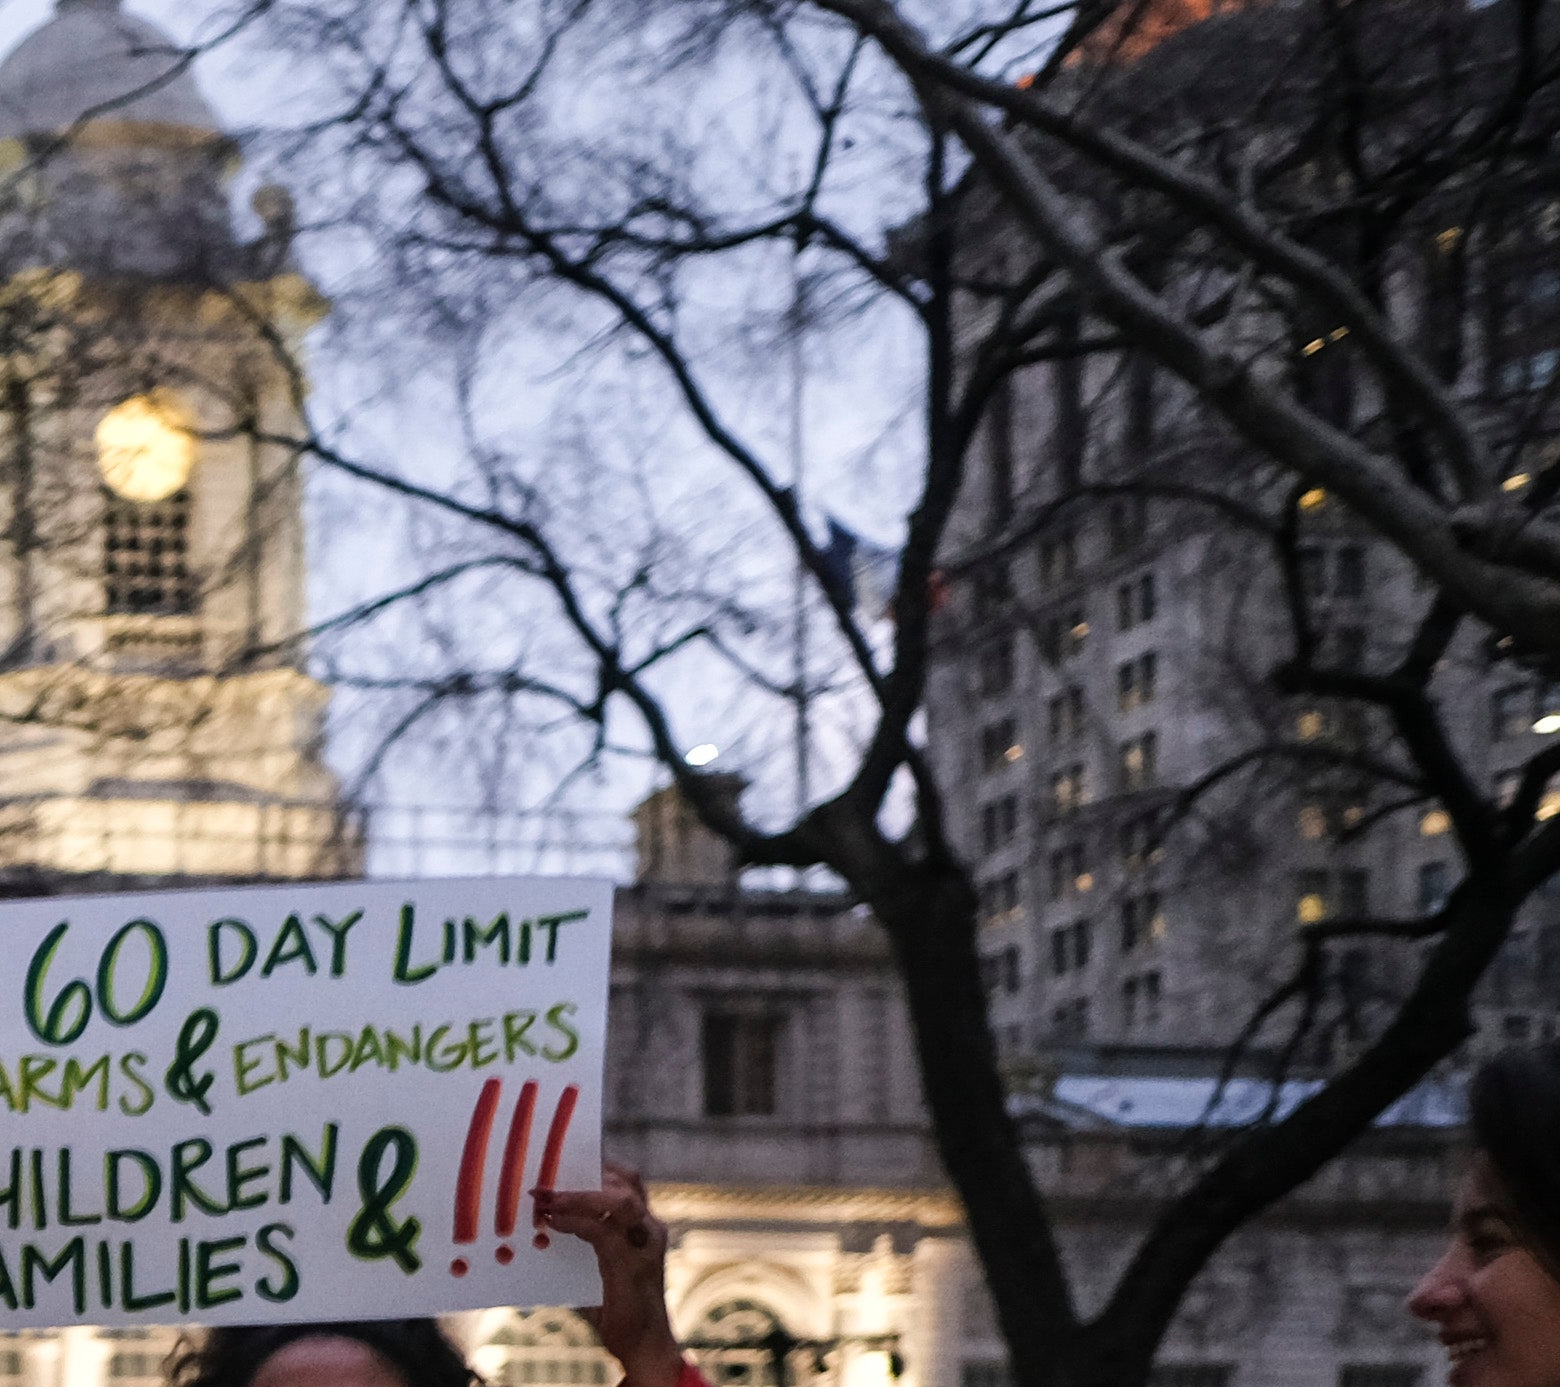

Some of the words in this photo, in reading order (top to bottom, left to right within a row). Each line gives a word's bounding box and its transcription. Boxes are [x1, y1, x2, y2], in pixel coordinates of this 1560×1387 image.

[23, 920, 170, 1047] 60
[208, 909, 364, 988] DAY
[392, 905, 590, 986] LIMIT
[165, 1008, 221, 1116] &
[235, 1003, 580, 1097] ENDANGERS
[346, 1126, 422, 1275] &
